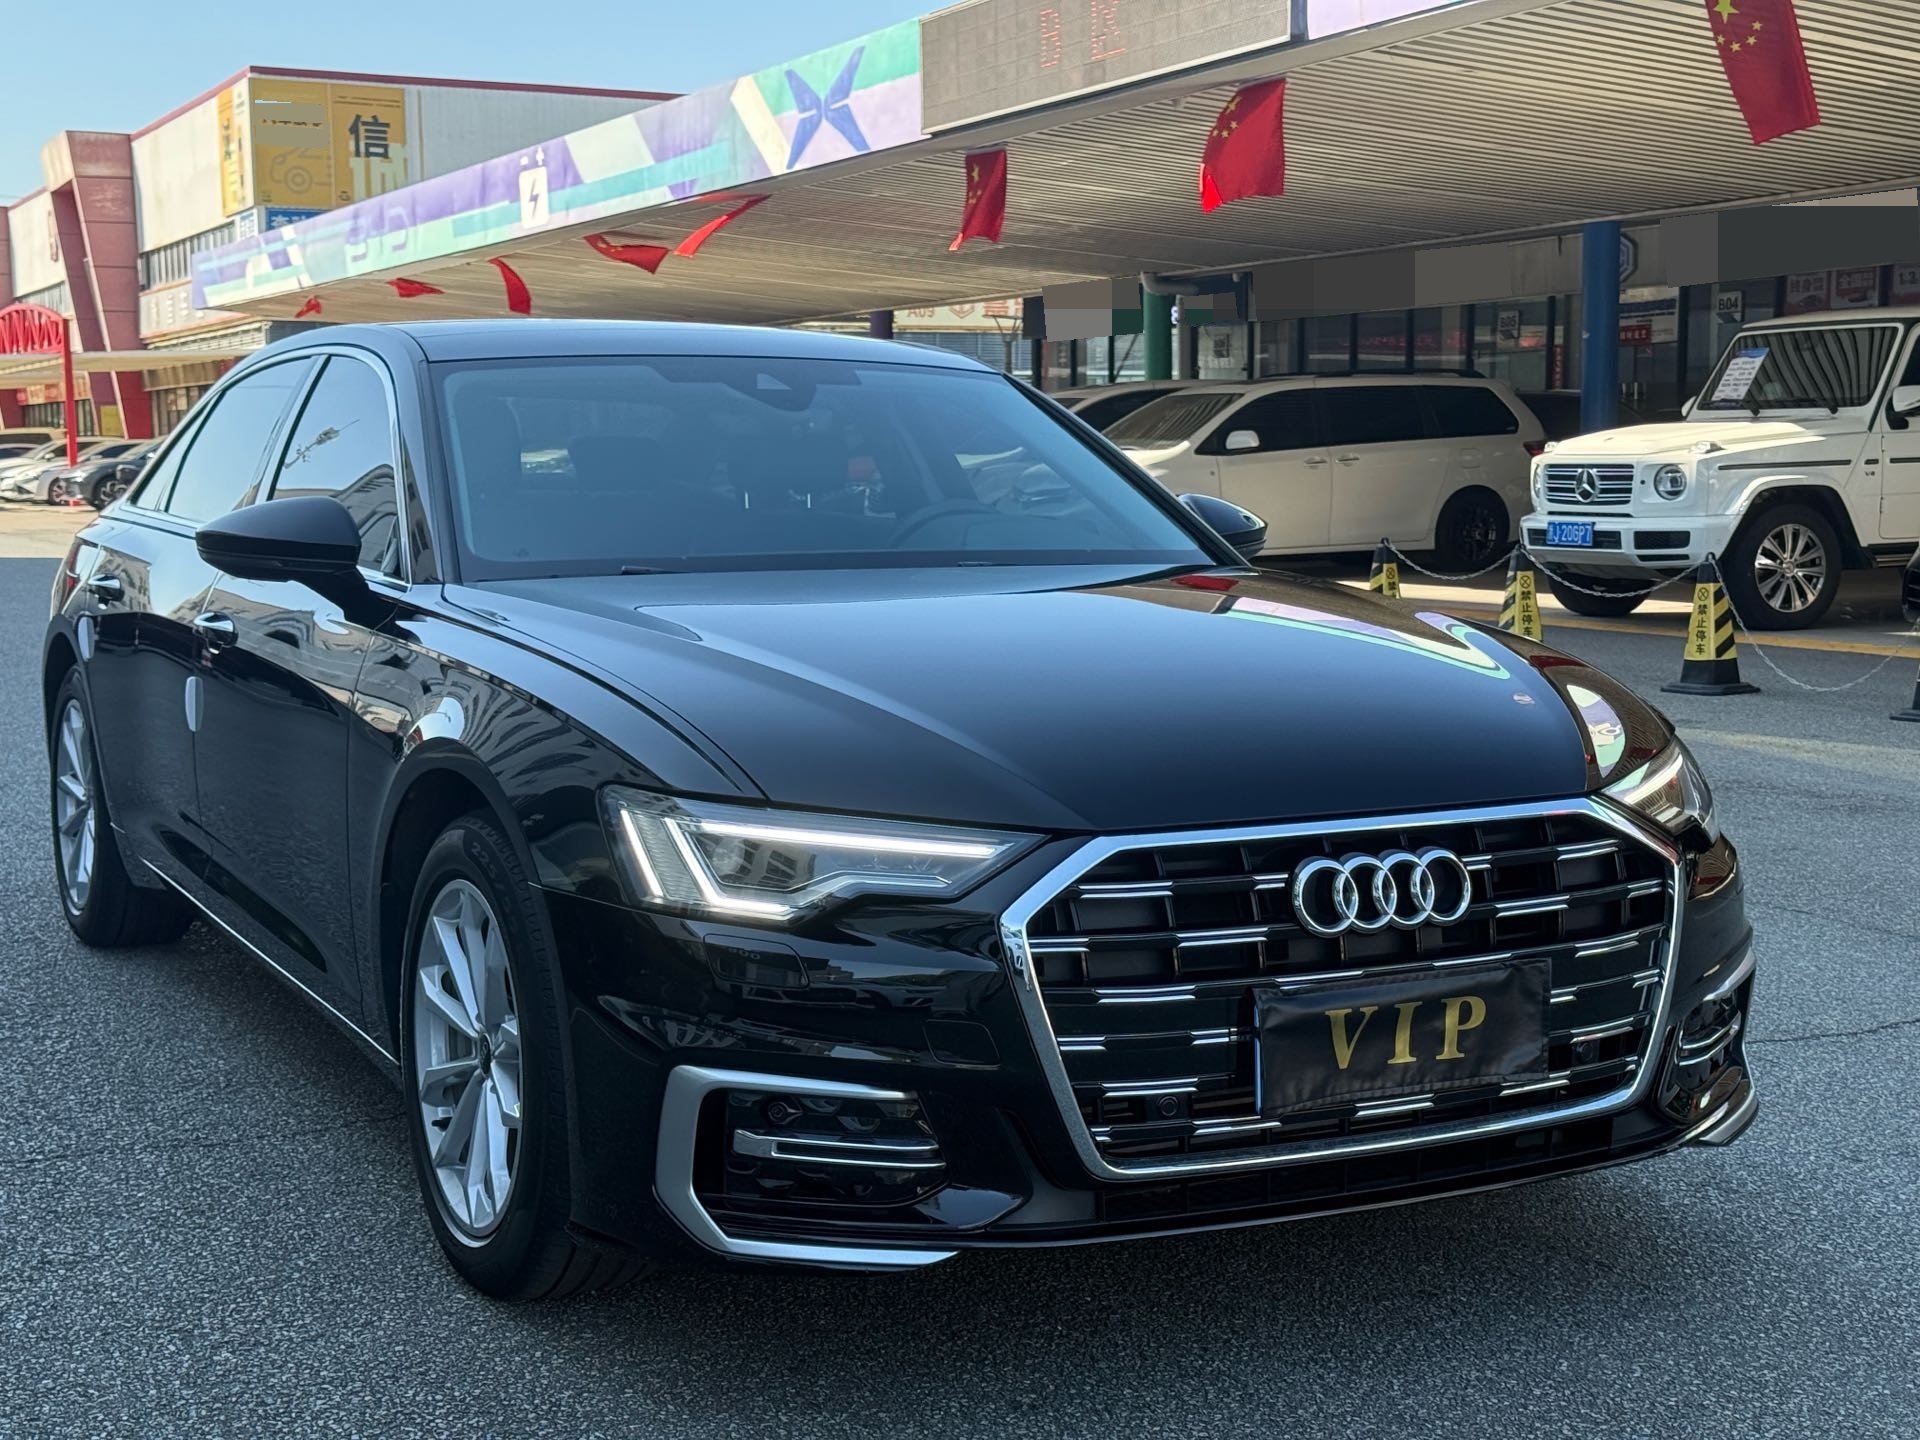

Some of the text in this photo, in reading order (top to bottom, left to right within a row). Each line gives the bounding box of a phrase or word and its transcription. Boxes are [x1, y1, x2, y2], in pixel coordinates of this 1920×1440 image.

[349, 114, 391, 160] 信
[1718, 297, 1738, 310] B04
[1520, 590, 1533, 637] 禁止停车
[1695, 604, 1708, 656] 禁止停车
[1325, 995, 1487, 1070] VIP
